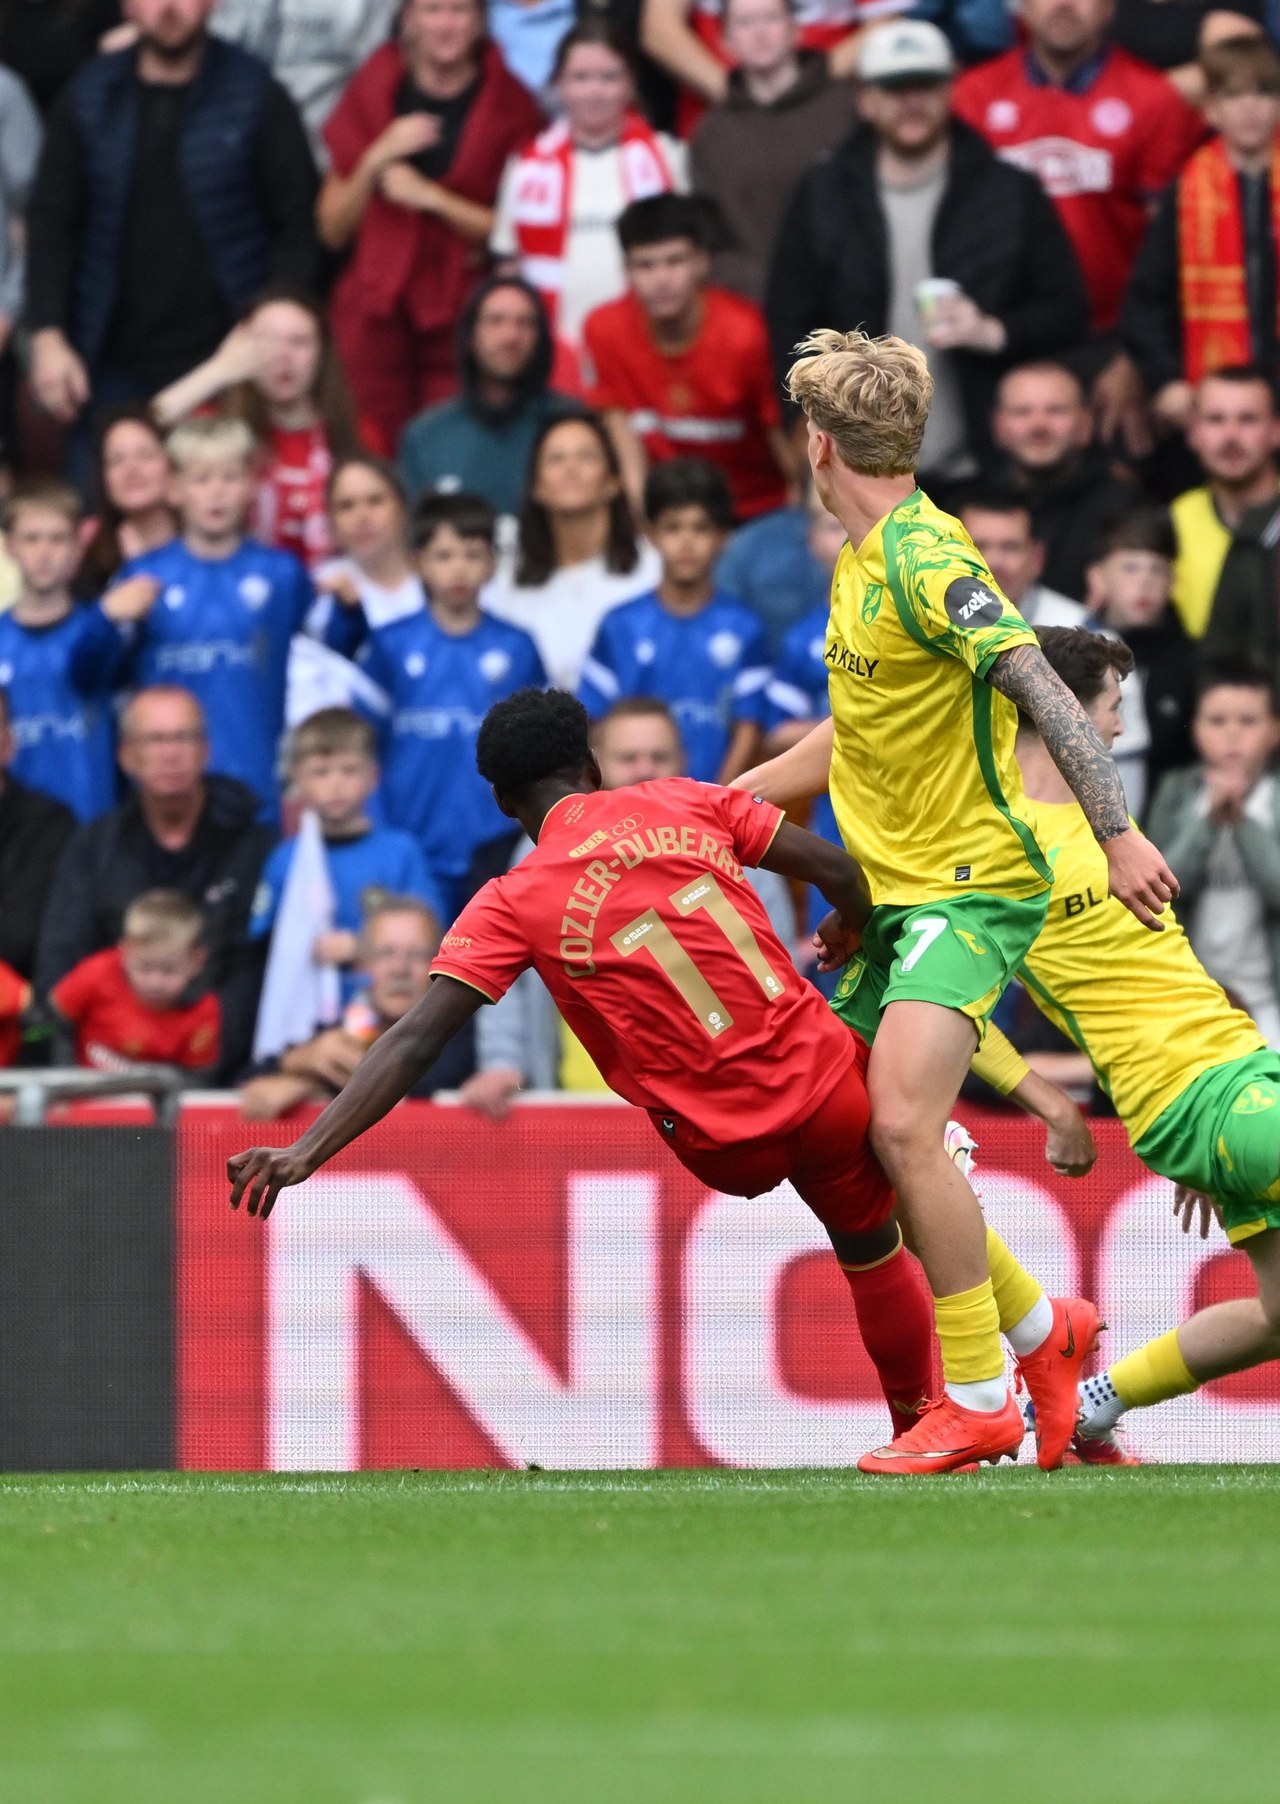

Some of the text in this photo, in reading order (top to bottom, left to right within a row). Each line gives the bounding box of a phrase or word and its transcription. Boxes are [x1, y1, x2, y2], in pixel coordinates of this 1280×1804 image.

[958, 589, 993, 620] zelt
[823, 642, 880, 678] AKELY
[608, 871, 786, 1039] 11
[901, 918, 948, 973] 7
